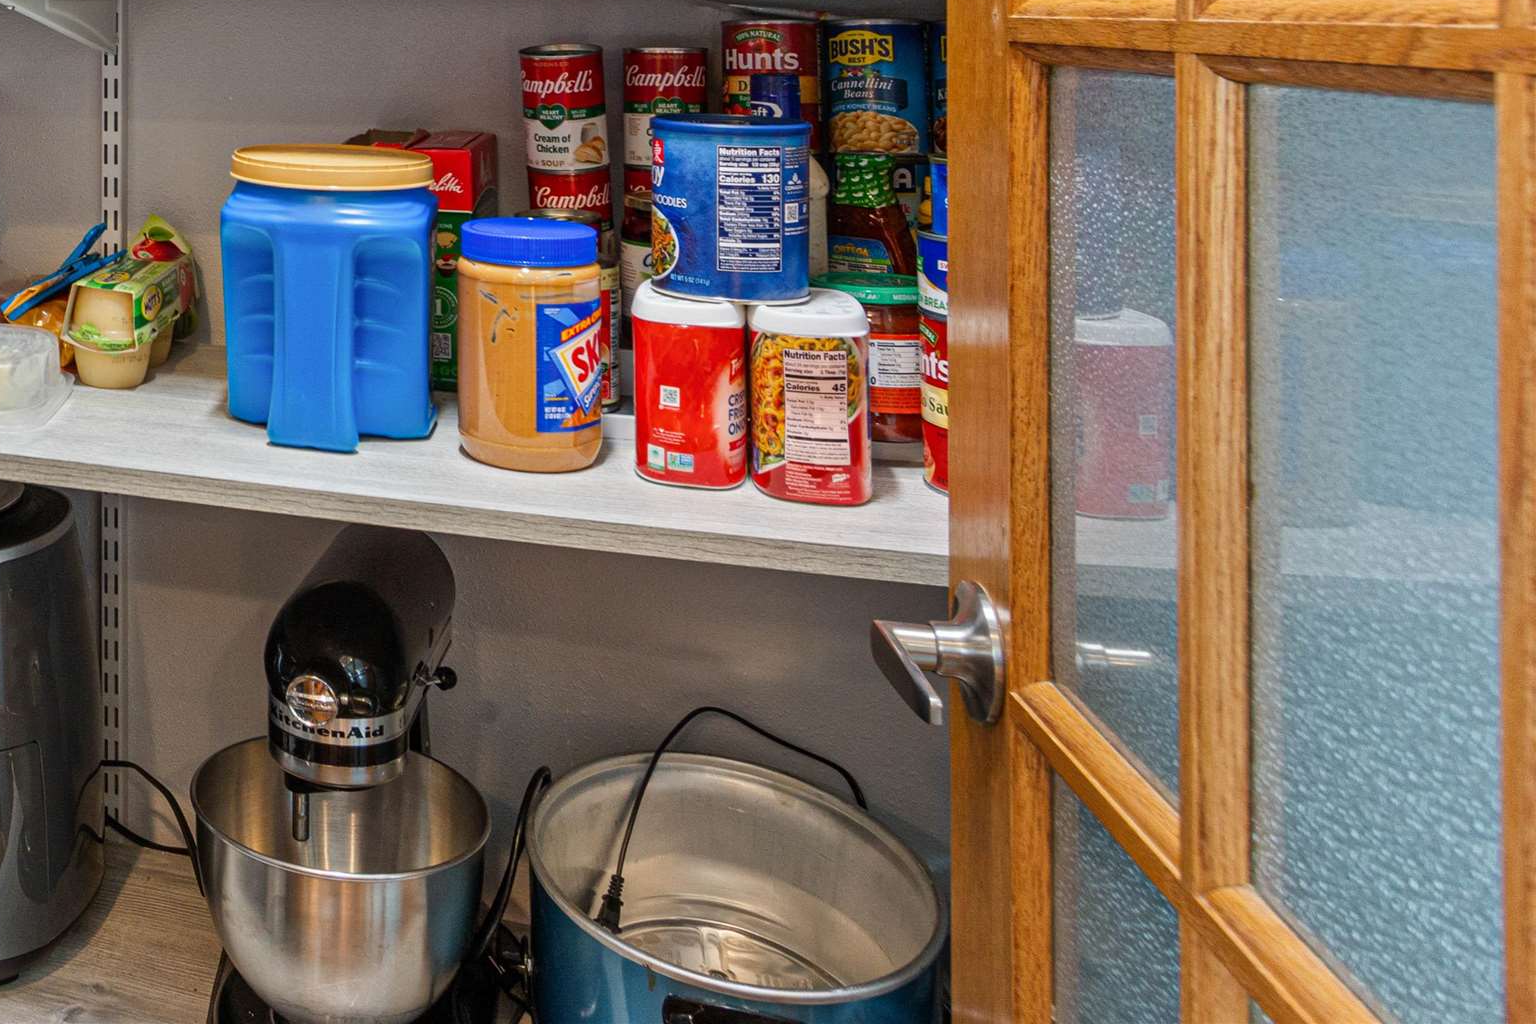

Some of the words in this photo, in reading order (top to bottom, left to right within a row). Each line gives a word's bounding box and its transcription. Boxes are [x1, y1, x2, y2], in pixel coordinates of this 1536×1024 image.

[750, 30, 781, 42] NATURAL
[831, 37, 890, 59] BUSH'S
[831, 77, 894, 92] Cannellini
[843, 89, 874, 99] Beans
[534, 133, 561, 143] Cream
[561, 133, 572, 142] of
[536, 143, 570, 154] Chicken
[719, 147, 758, 157] Nutrition
[759, 148, 780, 157] Facts
[541, 160, 565, 168] SOUP
[428, 172, 466, 194] elitta
[719, 176, 756, 184] Calories
[761, 173, 781, 184] 130
[535, 186, 610, 211] Campbell
[924, 296, 948, 311] BREA
[560, 317, 592, 343] EXTRA
[784, 349, 822, 361] Nutrition
[824, 352, 846, 361] Facts
[786, 383, 821, 392] Calories
[832, 384, 847, 393] 45
